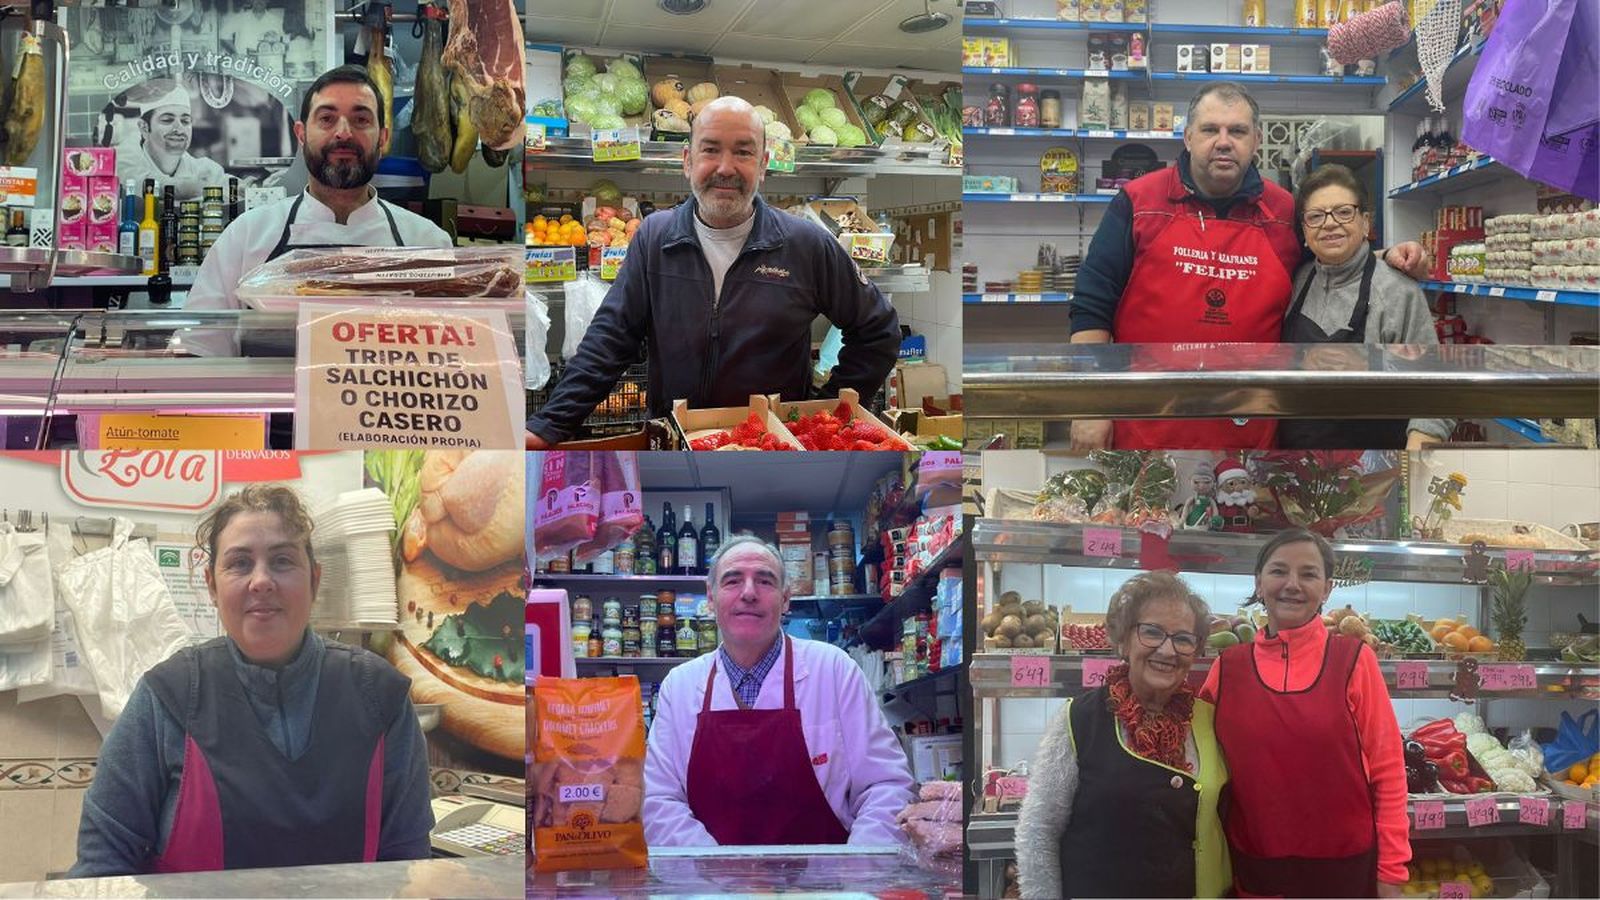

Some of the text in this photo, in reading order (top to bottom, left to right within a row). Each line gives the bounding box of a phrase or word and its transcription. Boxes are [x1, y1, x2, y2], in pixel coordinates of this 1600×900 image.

[103, 50, 180, 90] Calidad
[187, 52, 200, 69] y
[331, 321, 477, 347] OFERTA!
[344, 348, 462, 369] TRIPA DE
[325, 367, 489, 391] SALCHICHÓN
[340, 388, 479, 412] O CHORIZO
[105, 425, 181, 440] Atún-tomate
[358, 410, 463, 433] CASERO
[338, 431, 482, 449] (ELABORACIÓN PROPIA)
[224, 449, 291, 461] DERIVADOS
[99, 450, 207, 488] Lola
[564, 786, 601, 799] 2.00 €
